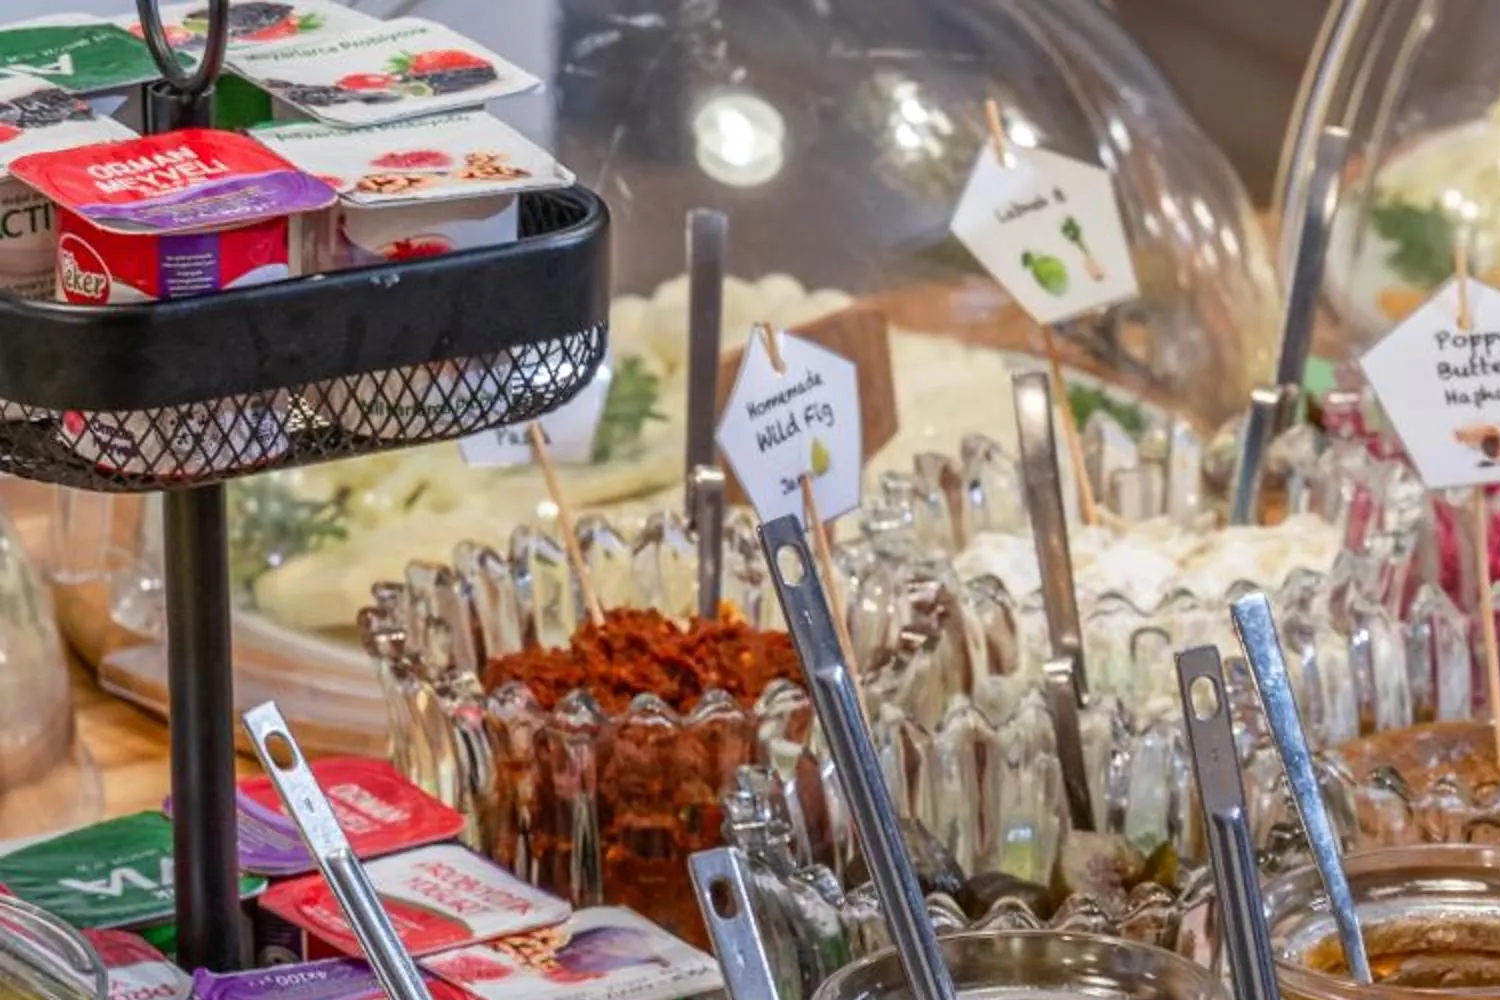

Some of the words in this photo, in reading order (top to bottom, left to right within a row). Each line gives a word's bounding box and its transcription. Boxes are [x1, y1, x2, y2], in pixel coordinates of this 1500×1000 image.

[746, 369, 824, 420] Homemade
[756, 411, 801, 453] Wild
[803, 402, 835, 428] Fig
